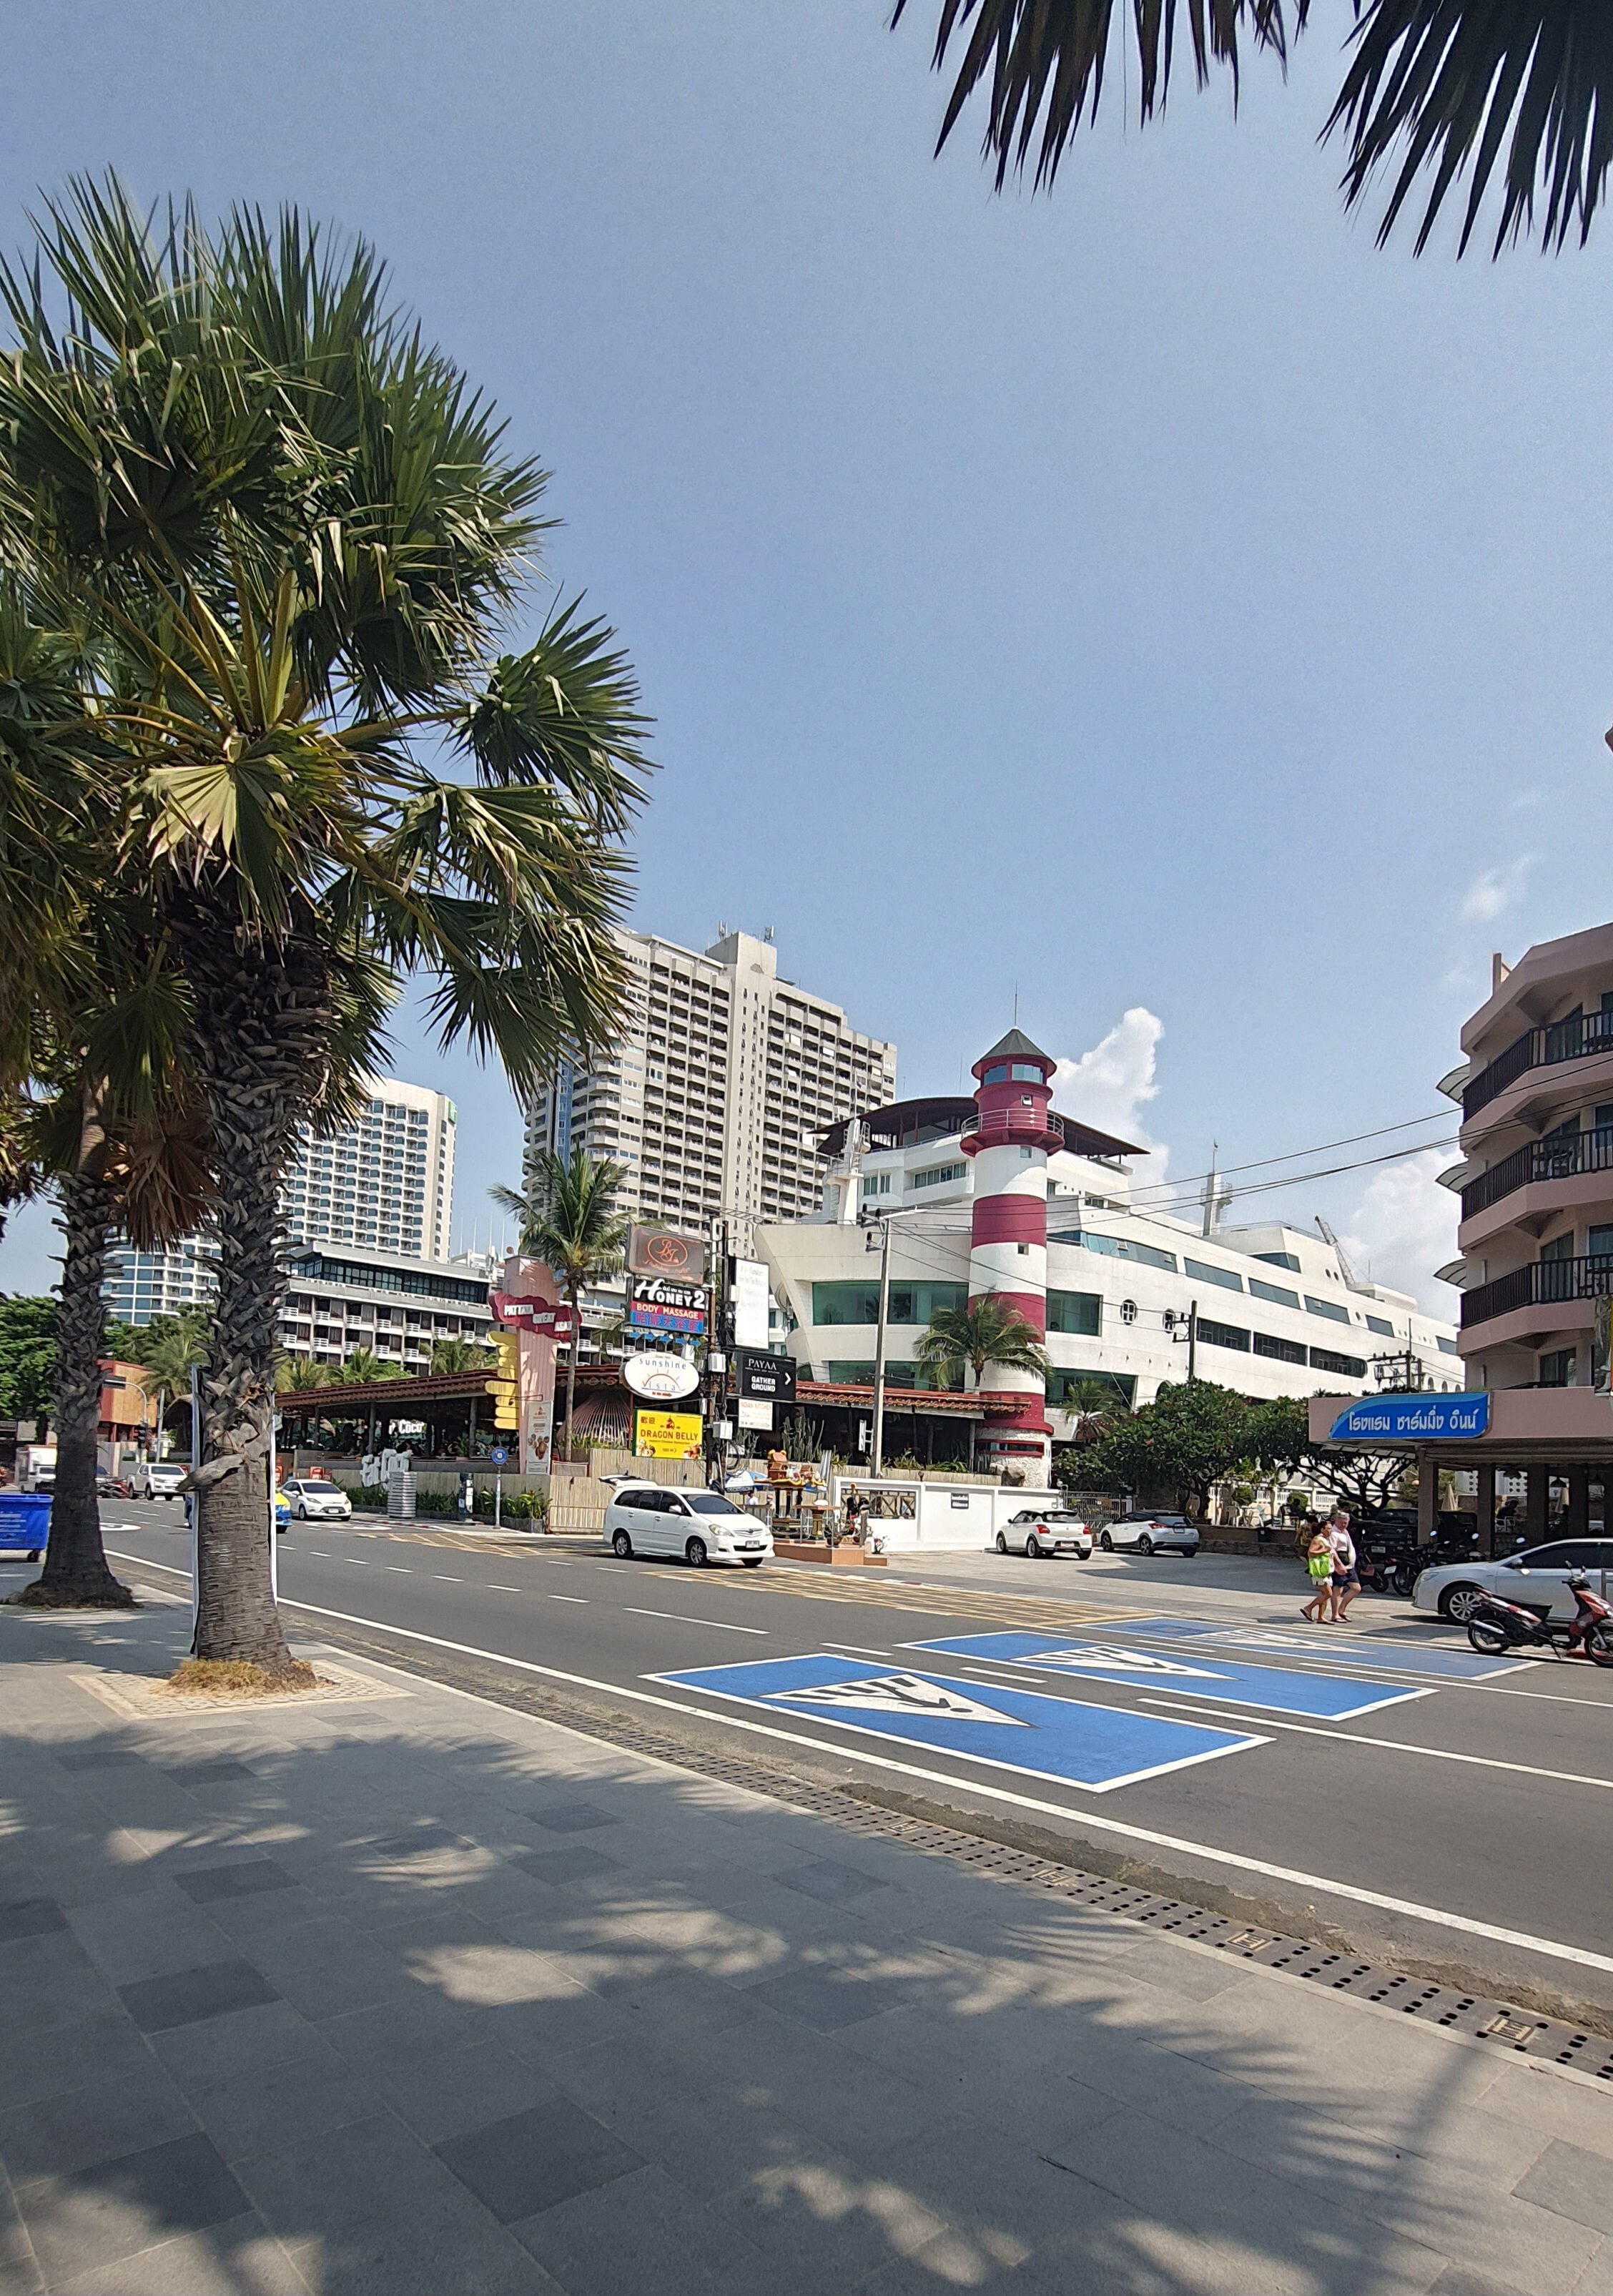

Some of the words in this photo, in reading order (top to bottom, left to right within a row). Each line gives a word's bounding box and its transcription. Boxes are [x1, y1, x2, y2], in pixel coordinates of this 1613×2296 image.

[634, 1278, 693, 1307] HONEY
[693, 1290, 705, 1309] 2
[636, 1303, 660, 1314] BODY
[663, 1306, 699, 1320] MASSAGE
[751, 1375, 776, 1386] GATHER
[751, 1382, 776, 1393] GROUND
[640, 1429, 674, 1439] DRAGON
[676, 1432, 699, 1441] BELLY
